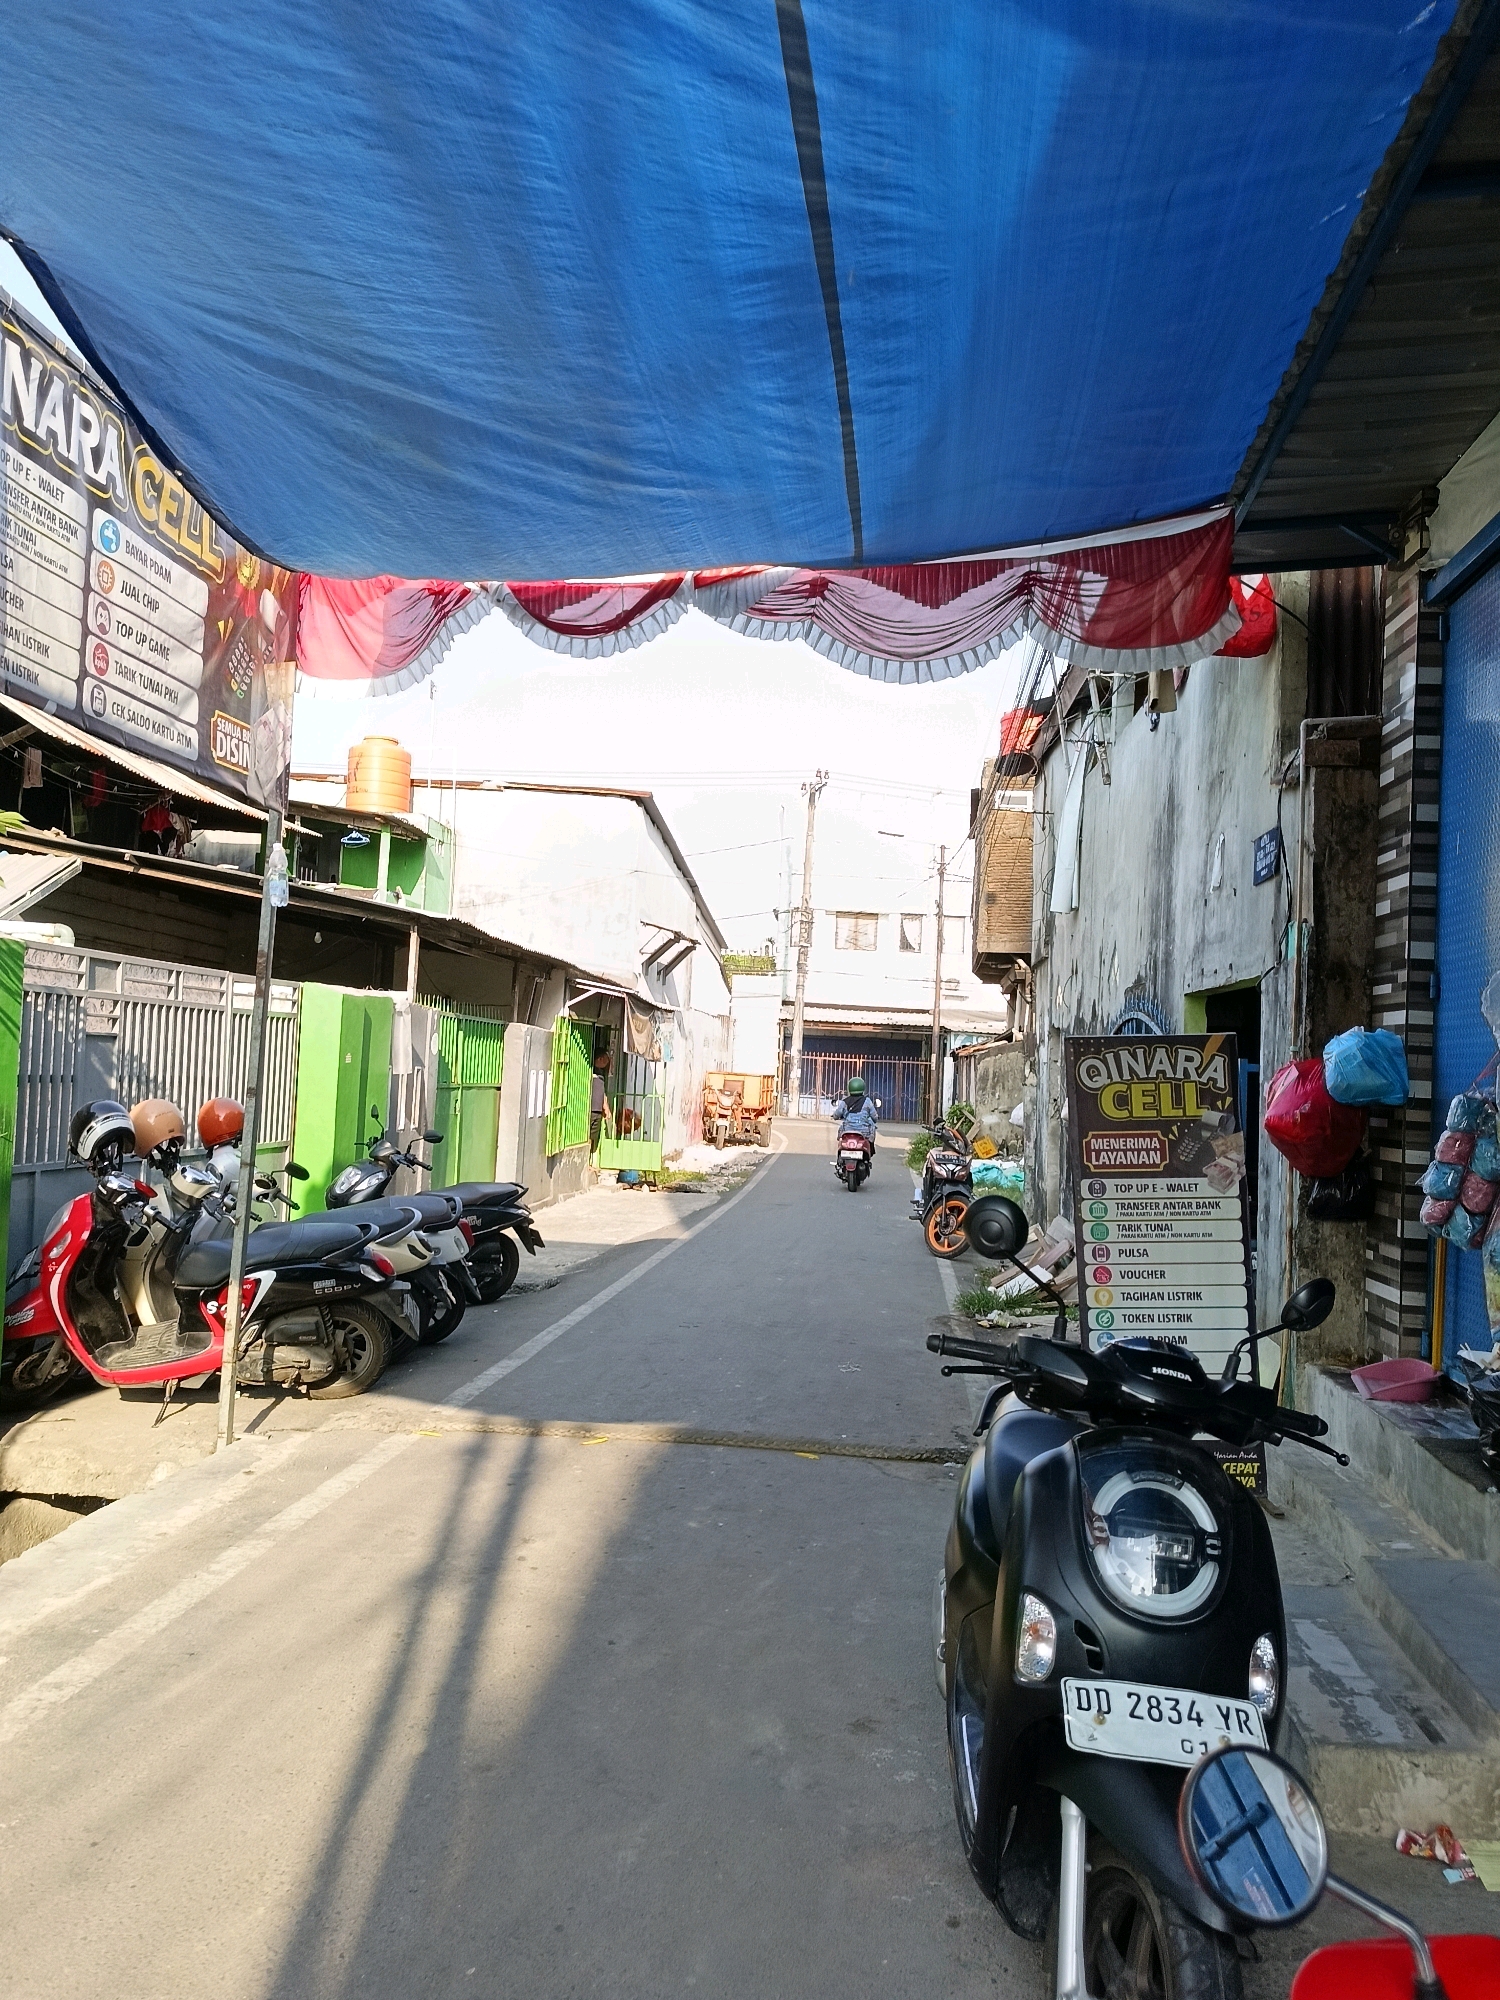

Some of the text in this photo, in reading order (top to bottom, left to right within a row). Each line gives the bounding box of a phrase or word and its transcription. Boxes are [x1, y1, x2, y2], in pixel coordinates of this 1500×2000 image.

[12, 457, 24, 476] UP
[25, 467, 32, 483] E
[38, 474, 65, 503] WALET
[31, 501, 57, 526] ANTAR
[58, 517, 79, 541] BANK
[134, 456, 222, 573] CELL
[13, 521, 37, 547] TUNAI
[125, 539, 173, 585] BAYAR PDAM
[120, 579, 160, 614] JUAL CHIP
[0, 619, 51, 660] IHAN LISTRIK
[115, 620, 171, 663] TOP UP GAME
[11, 663, 40, 687] LISTRIK
[114, 659, 179, 706] TARIK TUNAI PKH
[111, 701, 193, 751] CEK SALDO KARTU ATM
[216, 717, 242, 740] SEMUA
[1079, 1047, 1226, 1090] QINARA
[1099, 1081, 1206, 1119] CELL
[1090, 1137, 1161, 1150] MENERIMA
[1091, 1151, 1161, 1166] LAYANAN
[1114, 1183, 1134, 1193] TOP
[1135, 1183, 1150, 1193] UP
[1152, 1183, 1158, 1193] E
[1166, 1182, 1199, 1193] WALET
[1115, 1201, 1222, 1211] TRANSFER ANTAR BANK
[1116, 1223, 1173, 1233] TARIK TUNAI
[1118, 1248, 1149, 1258] PULSA
[1119, 1270, 1166, 1280] VOUCHER
[1120, 1291, 1203, 1301] TAGIHAN LISTRIK
[1122, 1313, 1193, 1323] TOKEN LISTRIK
[1152, 1366, 1192, 1382] HONDA
[1238, 1451, 1258, 1459] Anda
[1222, 1462, 1260, 1474] CEPAT
[1075, 1686, 1253, 1736] DD 2834 YR
